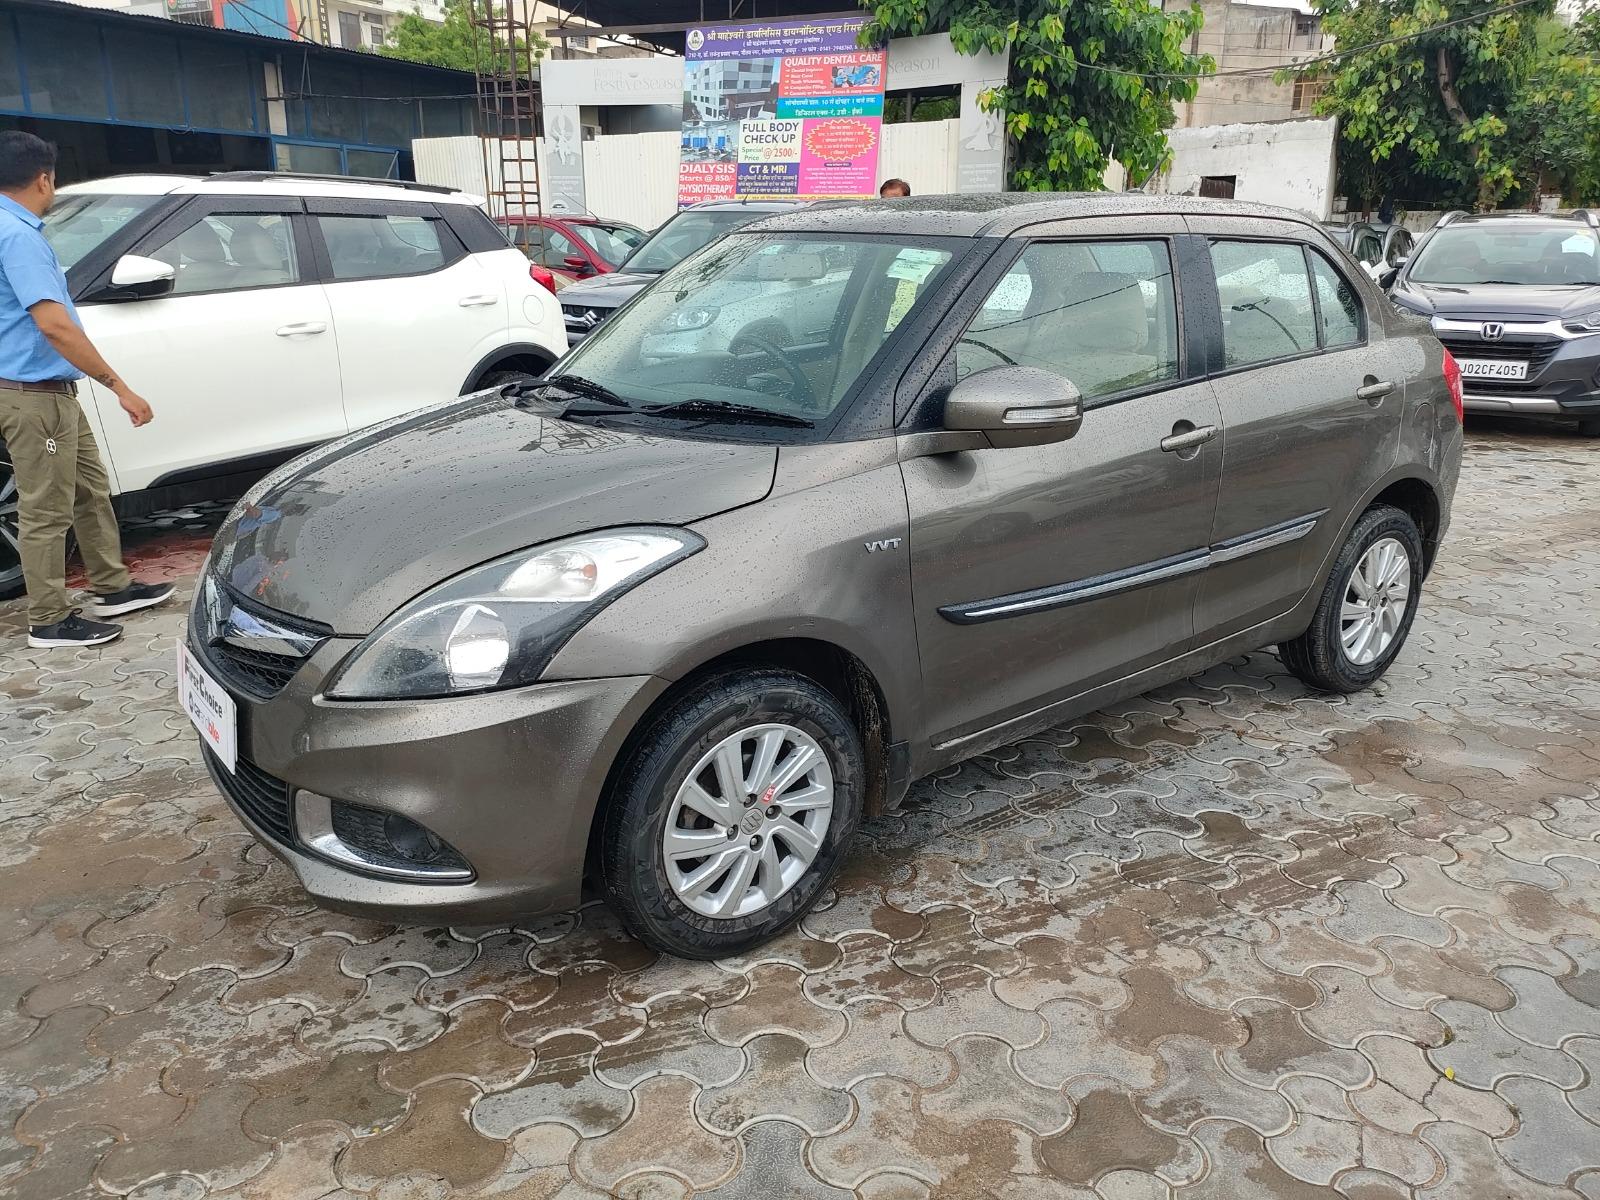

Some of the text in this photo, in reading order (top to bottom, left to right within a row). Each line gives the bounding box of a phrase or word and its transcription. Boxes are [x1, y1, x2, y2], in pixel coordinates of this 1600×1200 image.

[707, 30, 716, 40] श्री
[785, 53, 882, 67] QUALITY DENTAL CARE
[743, 122, 799, 132] FULL BODY
[744, 134, 796, 144] CHECK UP
[680, 163, 736, 173] DIALYSIS
[749, 165, 787, 174] CT & MRI
[679, 184, 734, 194] PHYSIOTHERAPY
[1458, 363, 1524, 377] J02CF4051
[863, 537, 902, 553] VVT
[199, 673, 223, 719] Choice
